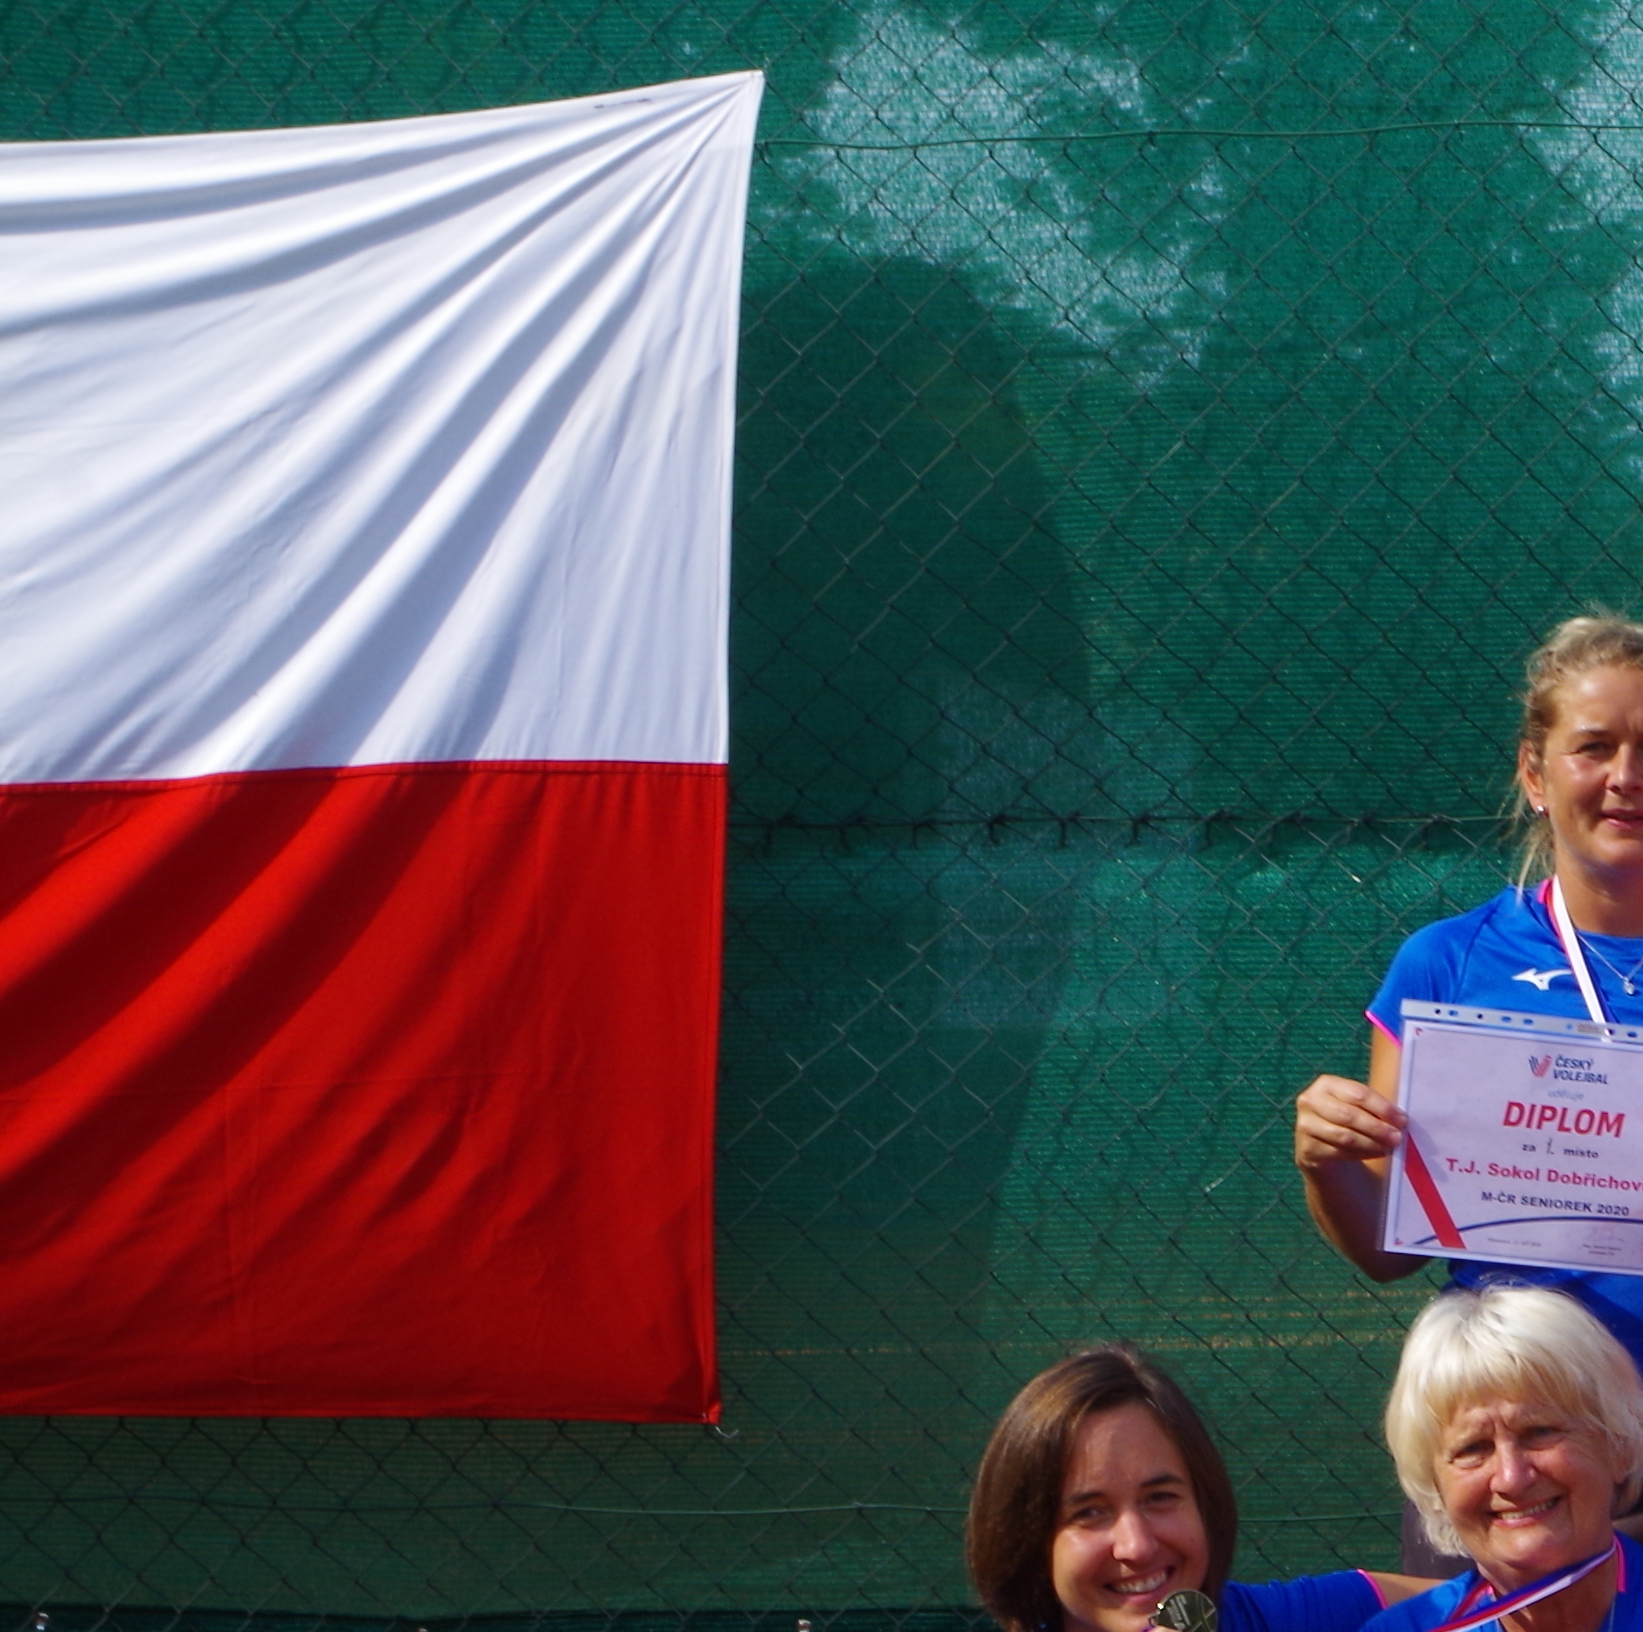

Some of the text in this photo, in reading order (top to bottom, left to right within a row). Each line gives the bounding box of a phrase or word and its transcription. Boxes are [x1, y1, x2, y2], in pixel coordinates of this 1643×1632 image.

[1555, 1054, 1594, 1071] ČESKÝ
[1552, 1069, 1609, 1085] VOLEJBAL
[1503, 1101, 1626, 1139] DIPLOM
[1522, 1143, 1537, 1152] za
[1446, 1157, 1481, 1175] T.J.
[1488, 1162, 1541, 1182] Sokol
[1481, 1190, 1630, 1217] M-ČR SENIOREK 2020
